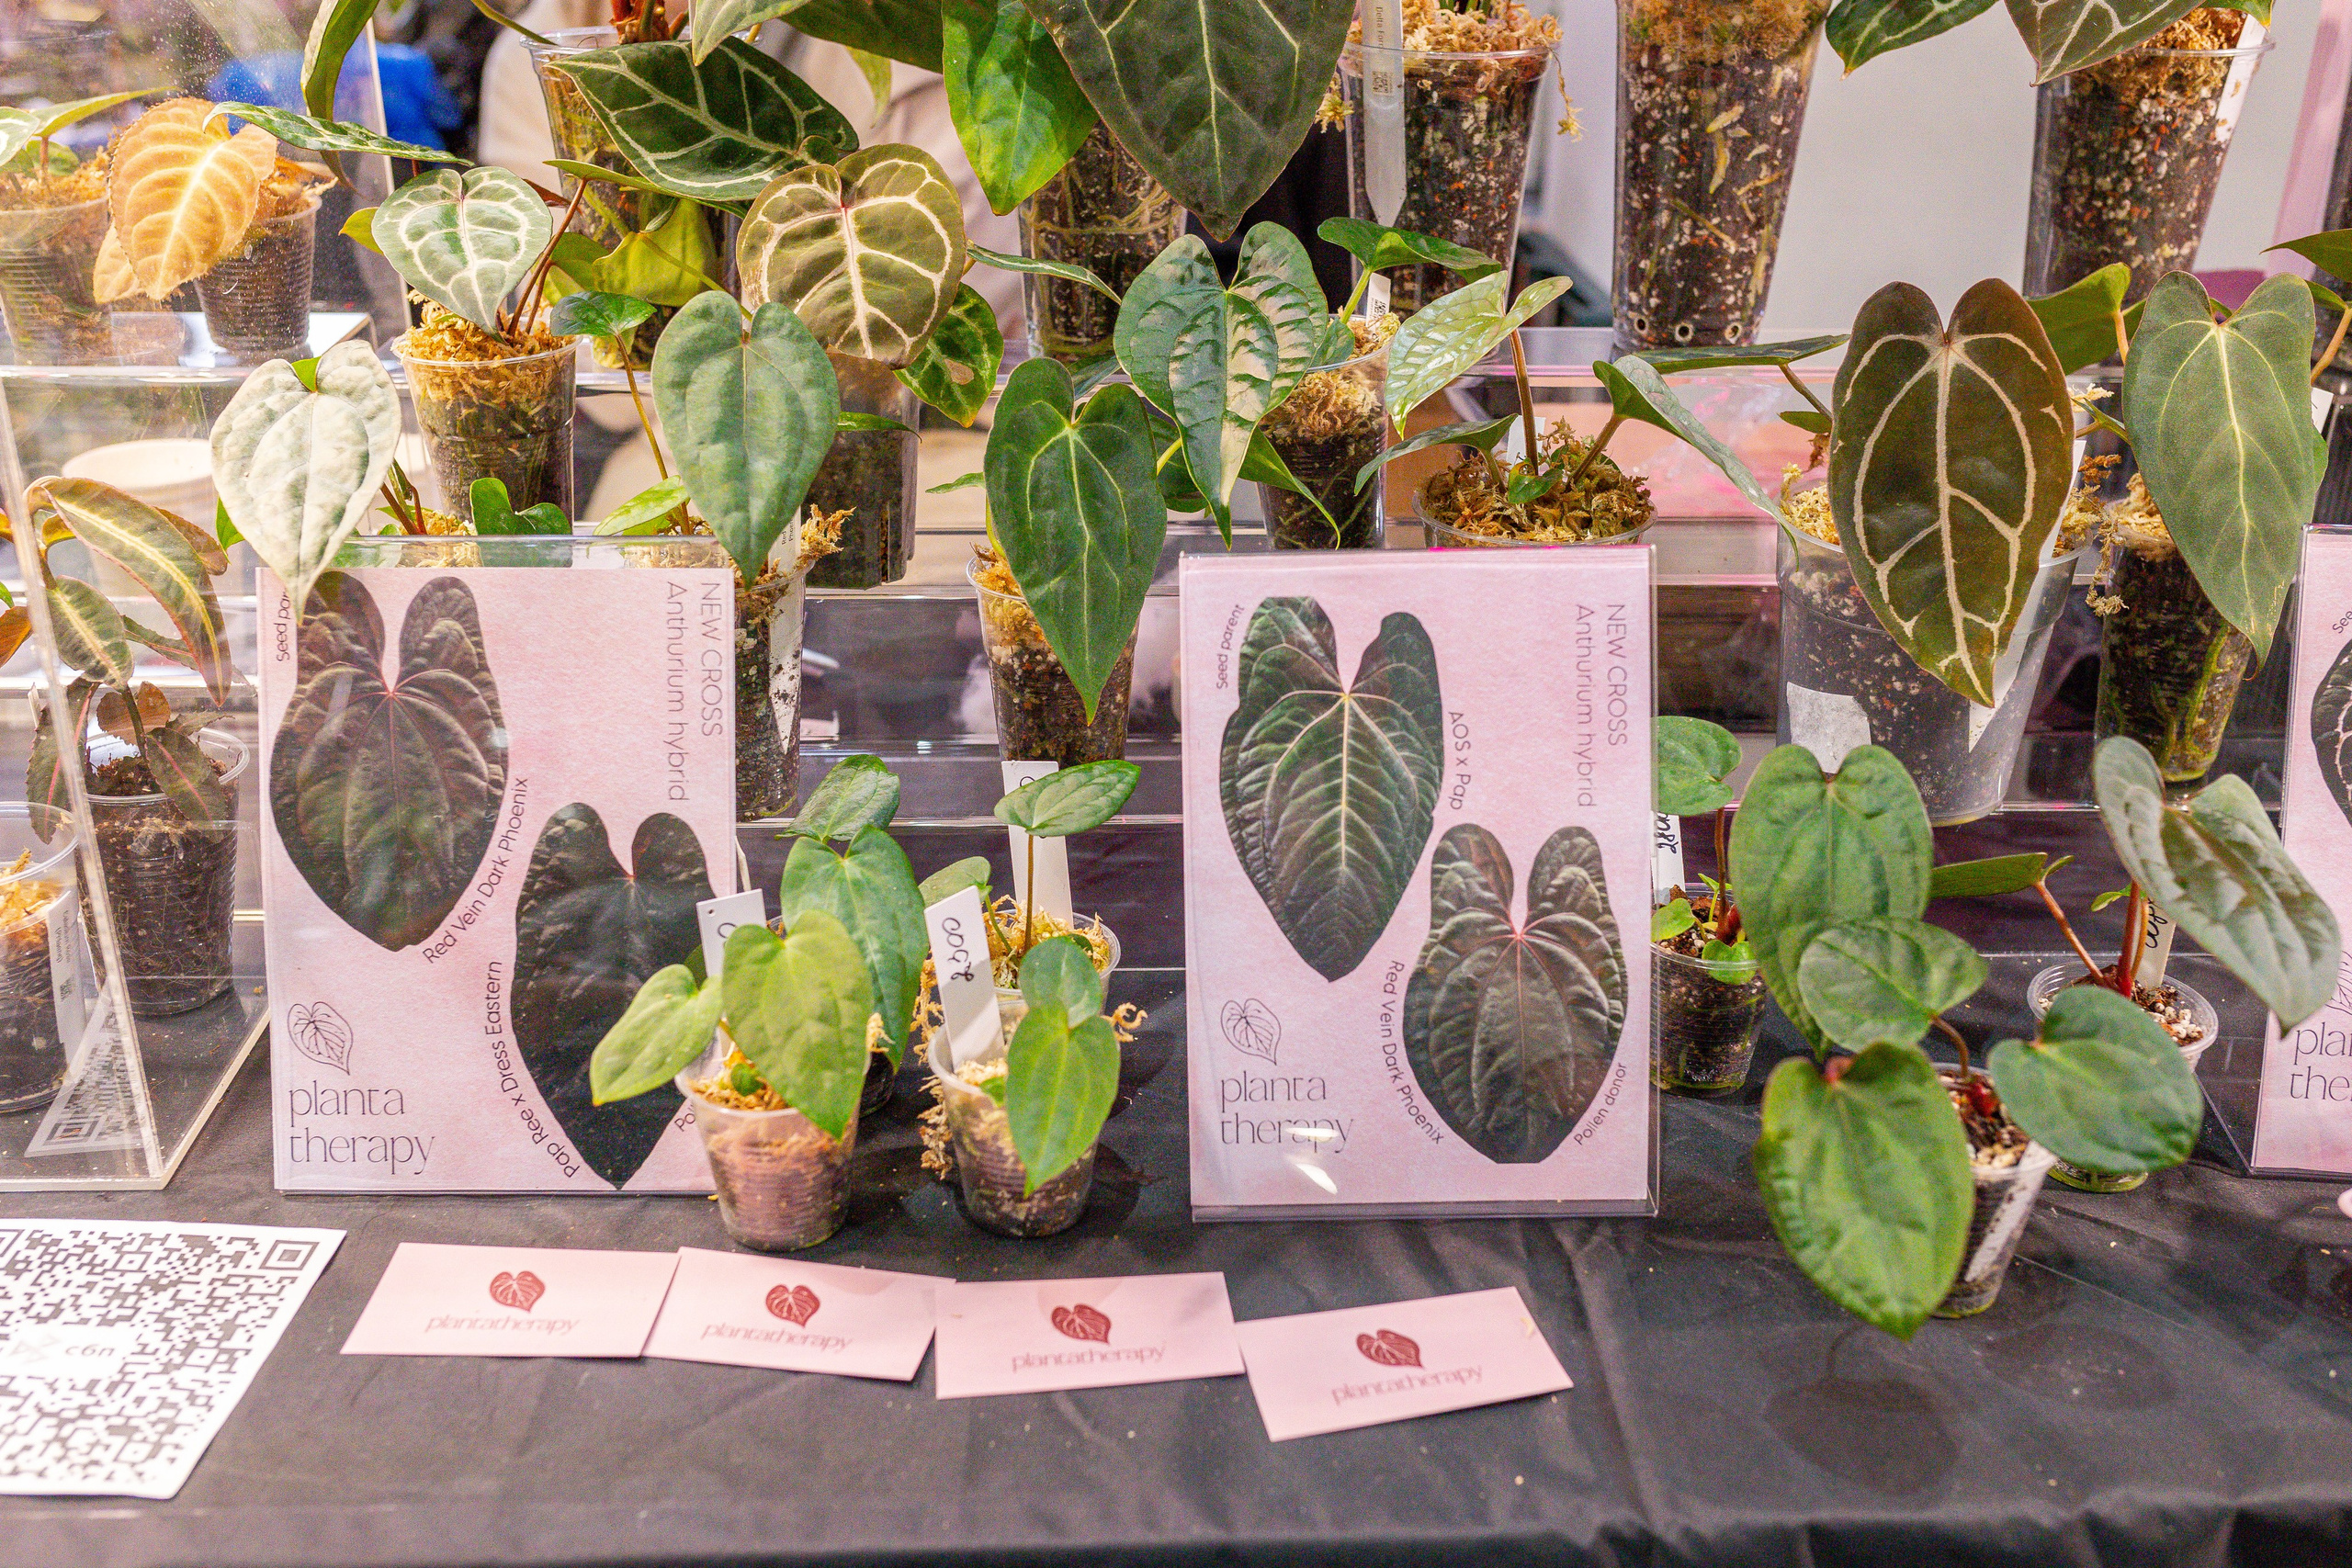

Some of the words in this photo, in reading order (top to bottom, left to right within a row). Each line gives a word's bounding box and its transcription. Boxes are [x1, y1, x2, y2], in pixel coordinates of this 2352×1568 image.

[277, 591, 291, 620] par
[700, 582, 722, 641] NEW
[1220, 604, 1245, 650] parent
[2332, 610, 2352, 634] See
[273, 623, 291, 661] Seed
[666, 581, 689, 712] Anthurium
[1606, 604, 1626, 659] NEW
[1216, 653, 1228, 689] Seed
[1575, 604, 1596, 725] Anthurium
[700, 649, 723, 737] CROSS
[1607, 666, 1628, 746] CROSS
[1448, 711, 1471, 751] AOS
[663, 722, 689, 800] hybrid
[1573, 733, 1597, 807] hybrid
[1448, 773, 1471, 810] Pap
[423, 931, 458, 964] Red
[451, 899, 486, 931] Vein
[477, 854, 510, 898] Dark
[498, 777, 528, 852] Phoenix
[485, 961, 503, 1035] Eastern
[1383, 960, 1406, 996] Red
[1380, 1000, 1396, 1039] Vein
[1382, 1043, 1404, 1084] Dark
[2293, 1021, 2352, 1066] pla
[492, 1040, 519, 1093] Dress
[2290, 1066, 2352, 1101] the
[288, 1079, 405, 1128] planta
[1221, 1070, 1327, 1113] planta
[1574, 1108, 1609, 1146] Pollen
[1604, 1062, 1627, 1106] donor
[520, 1108, 548, 1145] Ree
[1221, 1112, 1353, 1154] therapy
[1396, 1084, 1444, 1145] Phoenix
[290, 1127, 435, 1175] therapy
[547, 1142, 581, 1178] Pap
[424, 1314, 581, 1336] plantatherapy
[699, 1323, 854, 1353] plantatherapy
[1012, 1340, 1168, 1373] plantatherapy
[1331, 1365, 1483, 1406] plantatherapy
